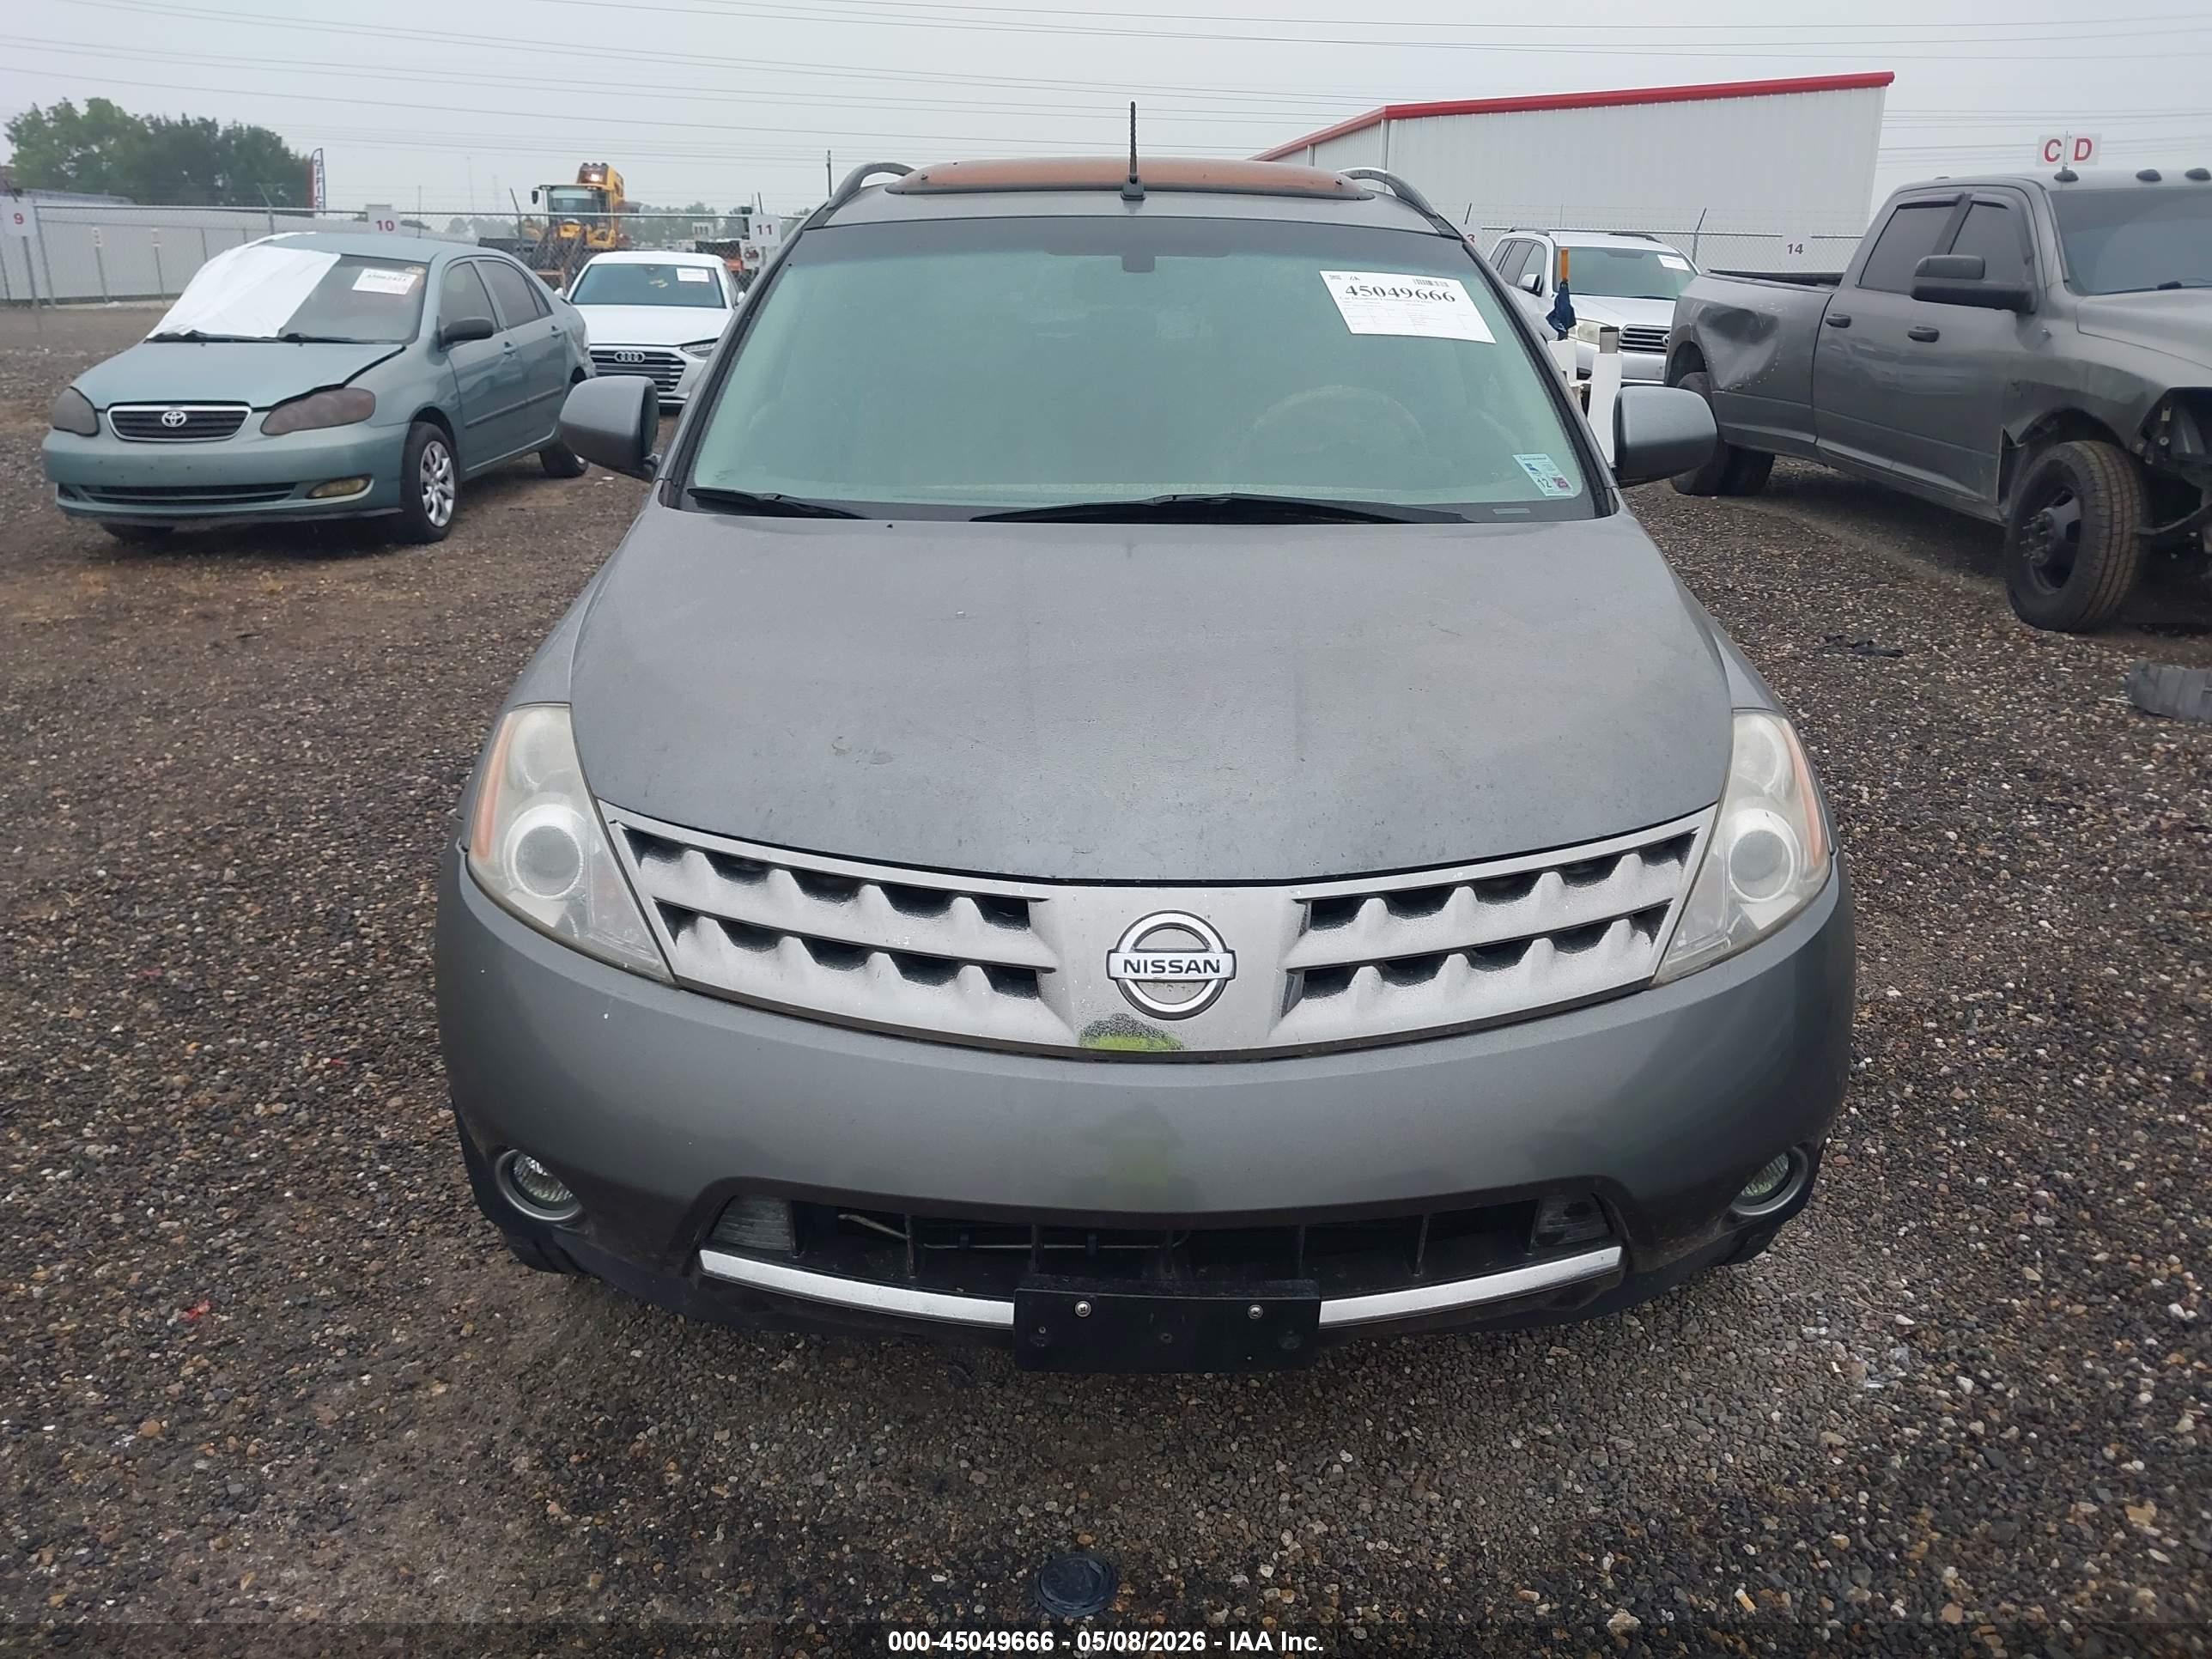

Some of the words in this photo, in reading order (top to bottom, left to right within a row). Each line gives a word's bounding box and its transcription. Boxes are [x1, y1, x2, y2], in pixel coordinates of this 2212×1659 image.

[2045, 138, 2062, 162] C
[2074, 137, 2093, 161] D
[13, 212, 24, 225] 9
[375, 220, 395, 232] 10
[757, 224, 773, 235] 11
[1786, 243, 1804, 255] 14
[1345, 284, 1456, 303] 45049666
[1123, 958, 1220, 975] NISSAN
